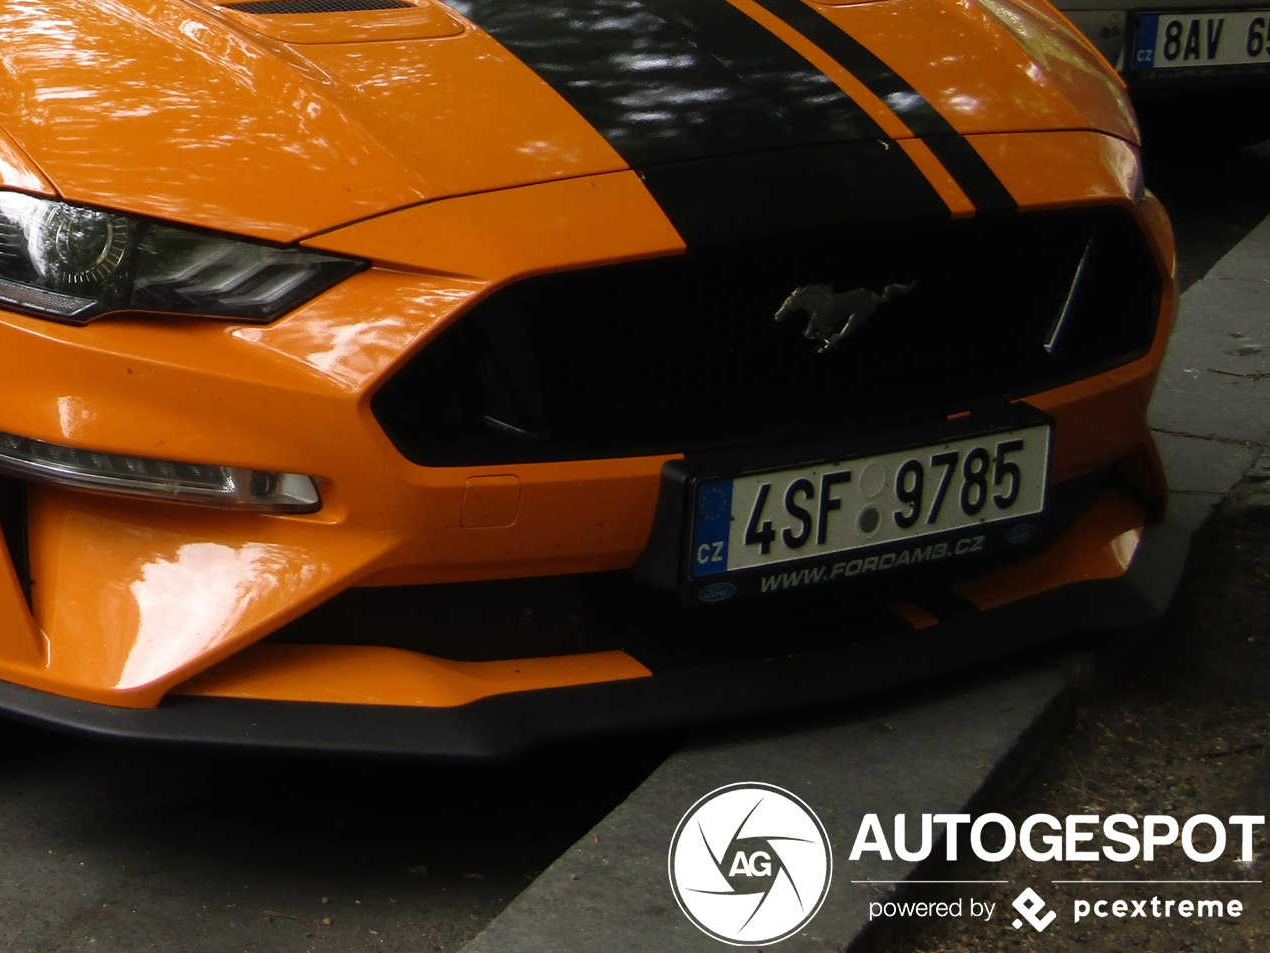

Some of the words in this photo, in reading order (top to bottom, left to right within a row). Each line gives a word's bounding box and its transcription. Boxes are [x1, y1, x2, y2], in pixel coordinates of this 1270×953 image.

[1137, 49, 1153, 61] CZ
[1163, 19, 1224, 60] 8AV
[1247, 17, 1270, 57] 6
[745, 470, 851, 554] 4SF
[894, 439, 1024, 528] 9785
[697, 540, 723, 564] CZ
